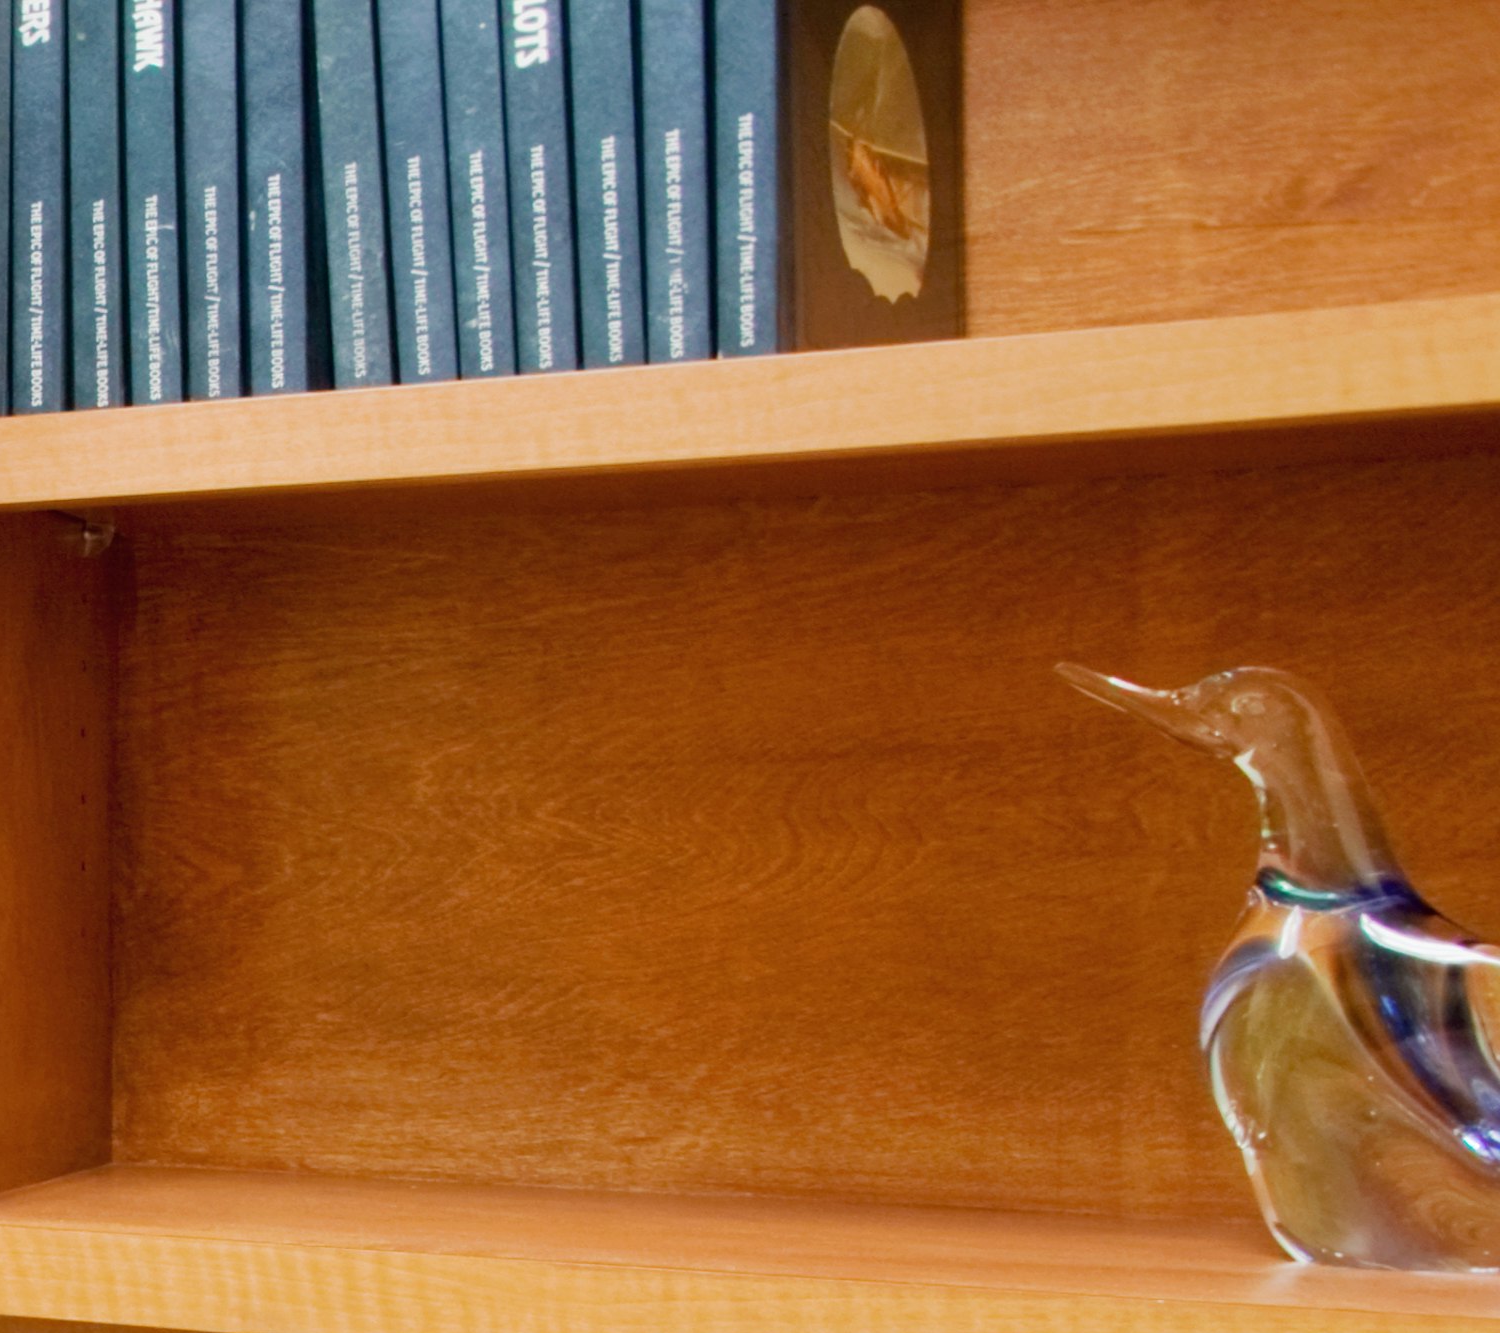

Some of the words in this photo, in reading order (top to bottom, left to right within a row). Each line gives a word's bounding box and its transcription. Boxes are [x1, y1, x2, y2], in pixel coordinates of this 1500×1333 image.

[665, 128, 680, 154] THE
[738, 113, 753, 139] THE
[469, 151, 483, 174] THE
[530, 144, 544, 169] THE
[600, 135, 615, 161] THE
[738, 140, 753, 168] EPIC
[267, 174, 280, 197] THE
[344, 162, 357, 185] THE
[407, 156, 421, 180] THE
[531, 170, 545, 197] EPIC
[601, 162, 616, 189] EPIC
[665, 155, 681, 183] EPIC
[145, 195, 157, 218] THE
[204, 186, 216, 208] THE
[345, 186, 358, 213] EPIC
[408, 180, 422, 207] EPIC
[470, 176, 484, 203] EPIC
[30, 201, 42, 223] THE
[92, 199, 104, 222] THE
[204, 210, 217, 236] EPIC
[267, 198, 281, 223] EPIC
[603, 208, 619, 250] FLIGHT
[666, 202, 682, 245] FLIGHT
[738, 187, 754, 232] FLIGHT
[30, 224, 42, 249] EPIC
[93, 223, 105, 248] EPIC
[145, 219, 158, 245] EPIC
[347, 230, 361, 271] FLIGHT
[410, 225, 425, 266] FLIGHT
[472, 221, 487, 262] FLIGHT
[532, 216, 547, 258] FLIGHT
[205, 252, 218, 293] FLIGHT
[268, 243, 282, 283] FLIGHT
[739, 243, 754, 301] TIME-LIFE
[30, 266, 42, 306] FLIGHT
[93, 265, 106, 305] FLIGHT
[412, 277, 428, 332] TIME-LIFE
[475, 273, 490, 328] TIME-LIFE
[534, 269, 549, 325] TIME-LIFE
[605, 262, 621, 318] TIME-LIFE
[269, 292, 283, 347] TIME-LIFE
[349, 281, 364, 335] TIME-LIFE
[739, 303, 755, 346] BOOKS
[30, 315, 42, 367] TIME-LIFE
[94, 315, 107, 367] TIME-LIFE
[206, 304, 219, 357] TIME-LIFE
[536, 327, 551, 368] BOOKS
[607, 320, 623, 362] BOOKS
[668, 316, 684, 358] BOOKS
[270, 349, 284, 388] BOOKS
[351, 338, 365, 377] BOOKS
[415, 334, 430, 374] BOOKS
[477, 330, 492, 371] BOOKS
[30, 369, 42, 406] BOOKS
[95, 369, 108, 407] BOOKS
[148, 362, 161, 400] BOOKS
[207, 359, 220, 397] BOOKS
